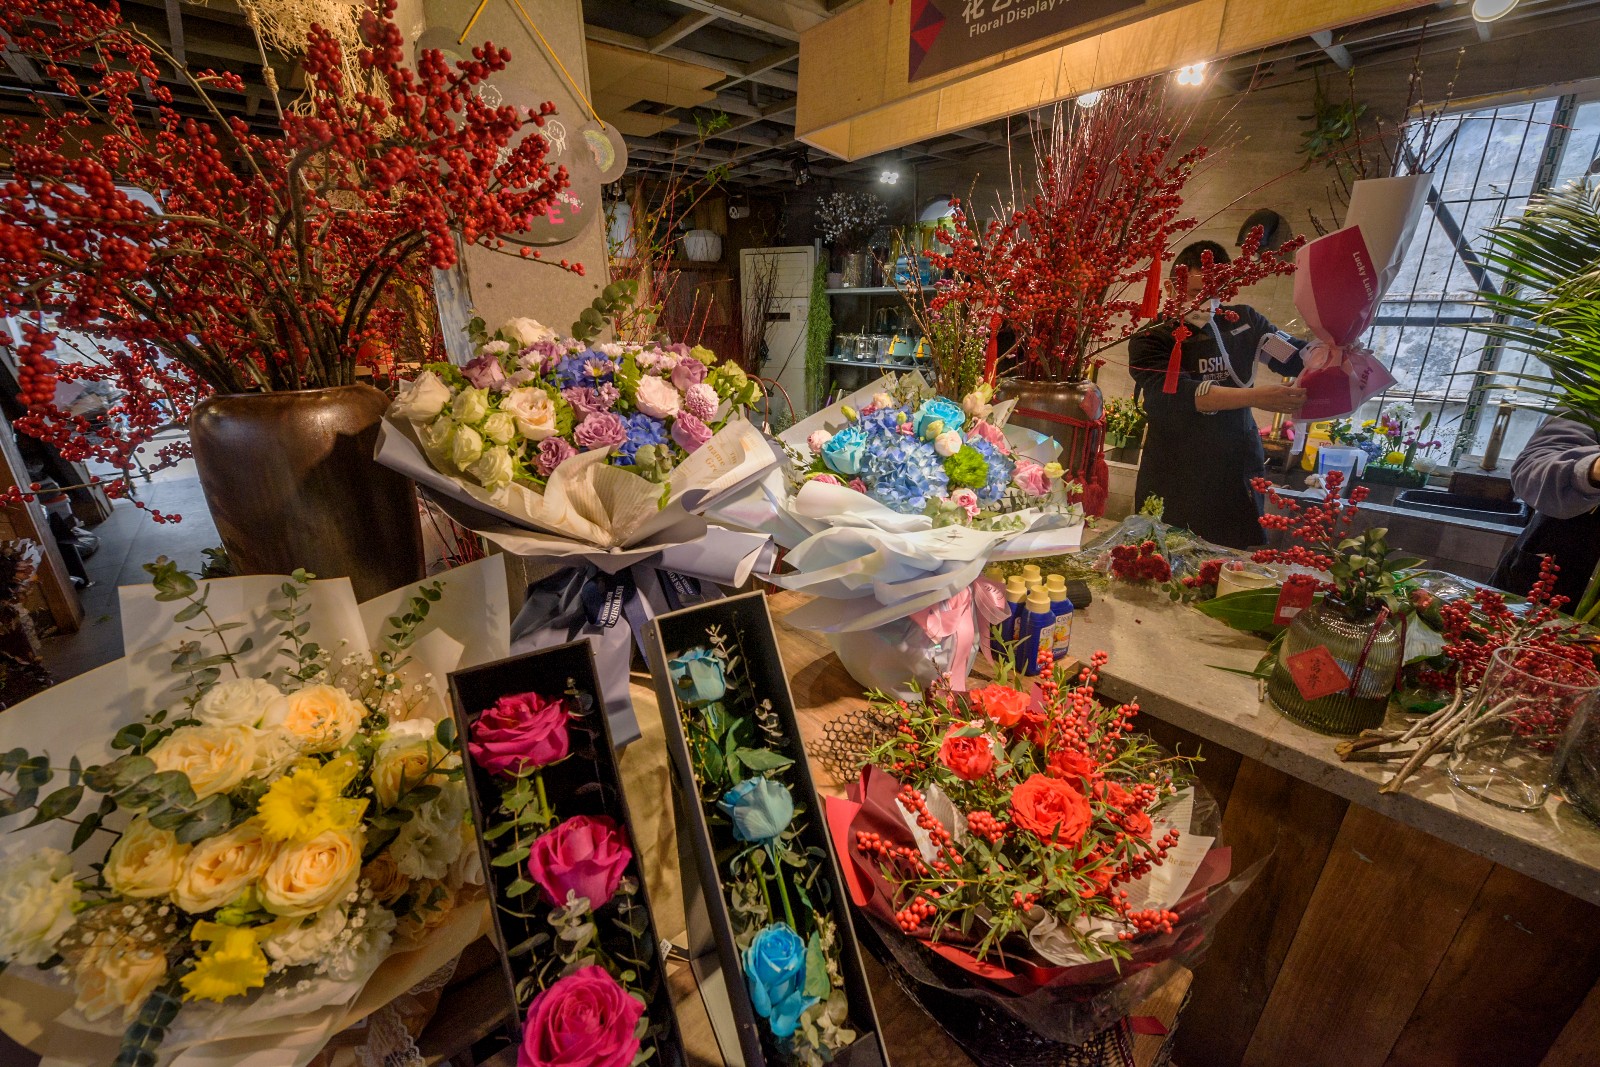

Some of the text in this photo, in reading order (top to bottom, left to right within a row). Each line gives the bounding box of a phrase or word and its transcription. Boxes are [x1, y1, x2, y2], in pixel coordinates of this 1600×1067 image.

[969, 0, 1057, 38] Floral Display
[1352, 251, 1367, 276] Lucky
[1198, 356, 1228, 374] DSH
